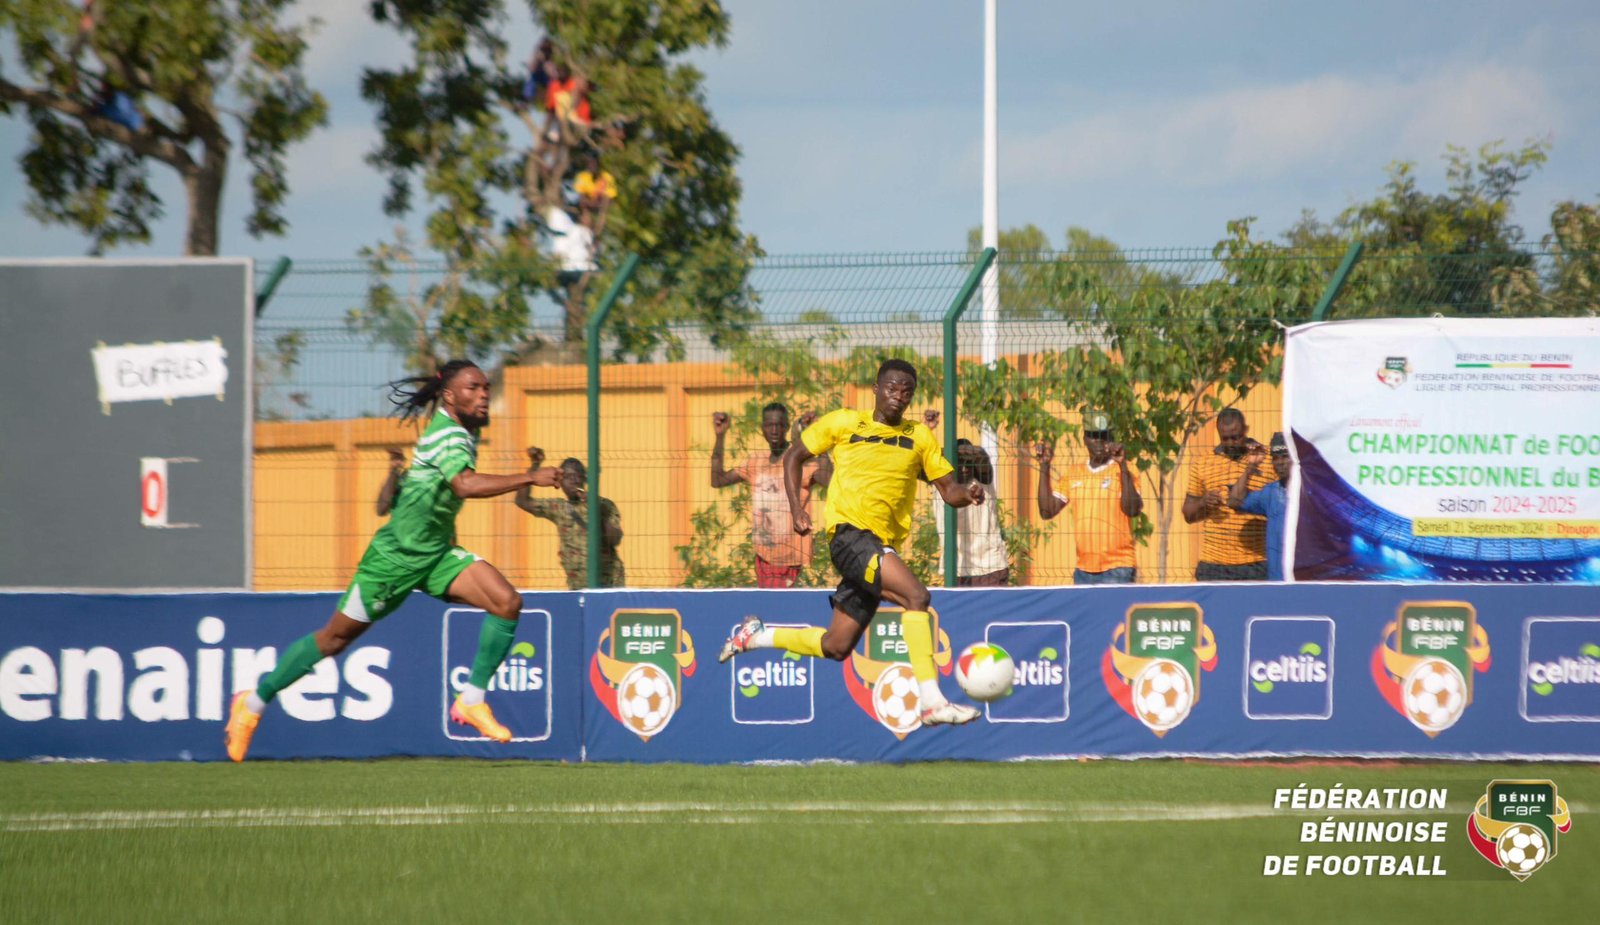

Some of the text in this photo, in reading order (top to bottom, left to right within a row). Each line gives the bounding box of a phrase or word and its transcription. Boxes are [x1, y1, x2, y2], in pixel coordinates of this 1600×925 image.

[1541, 373, 1552, 382] DE
[1450, 383, 1462, 392] DE
[1348, 432, 1600, 456] CHAMPIONNAT de FOO
[1357, 464, 1545, 488] PROFESSIONNEL
[1551, 466, 1579, 488] du
[1438, 495, 1577, 514] saison 2024-2025
[621, 623, 671, 637] BÉNIN
[1137, 617, 1192, 632] BÉNIN
[1407, 616, 1465, 632] BÉNIN
[625, 641, 666, 655] FBF
[1140, 635, 1186, 650] FBF
[1411, 634, 1459, 650] FBF
[450, 658, 543, 692] ctiis
[737, 660, 807, 688] celtiis
[1250, 655, 1327, 683] celtiis
